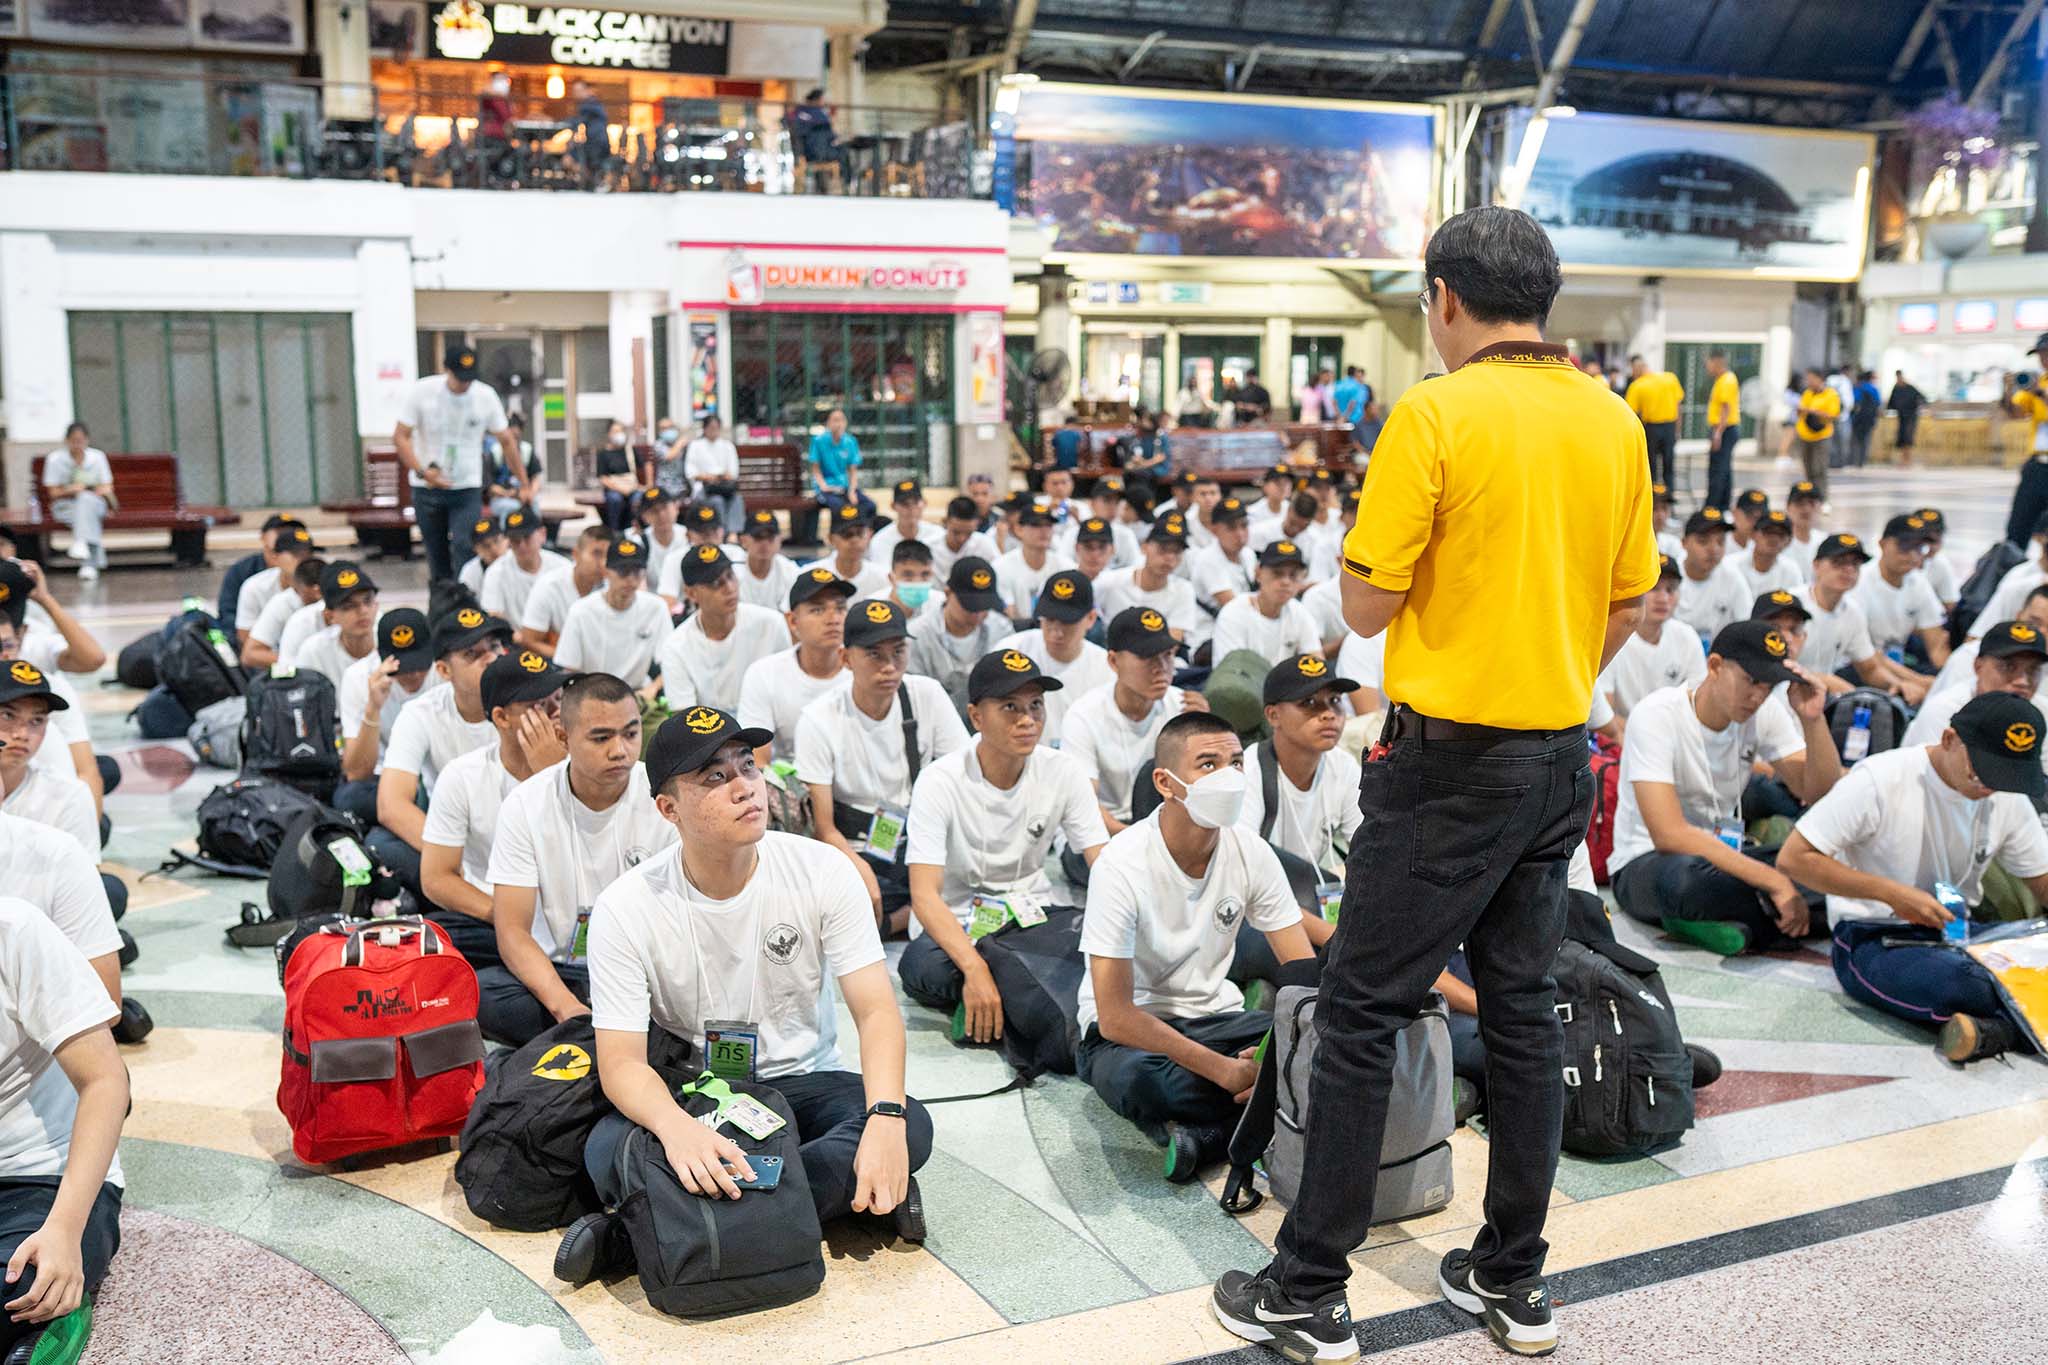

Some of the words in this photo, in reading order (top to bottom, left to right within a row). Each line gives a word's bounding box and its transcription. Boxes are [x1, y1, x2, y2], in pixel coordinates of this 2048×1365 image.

[493, 4, 601, 39] BLACK
[600, 11, 726, 45] CANYON
[551, 36, 671, 68] COFFEE
[871, 266, 969, 288] DONUTS
